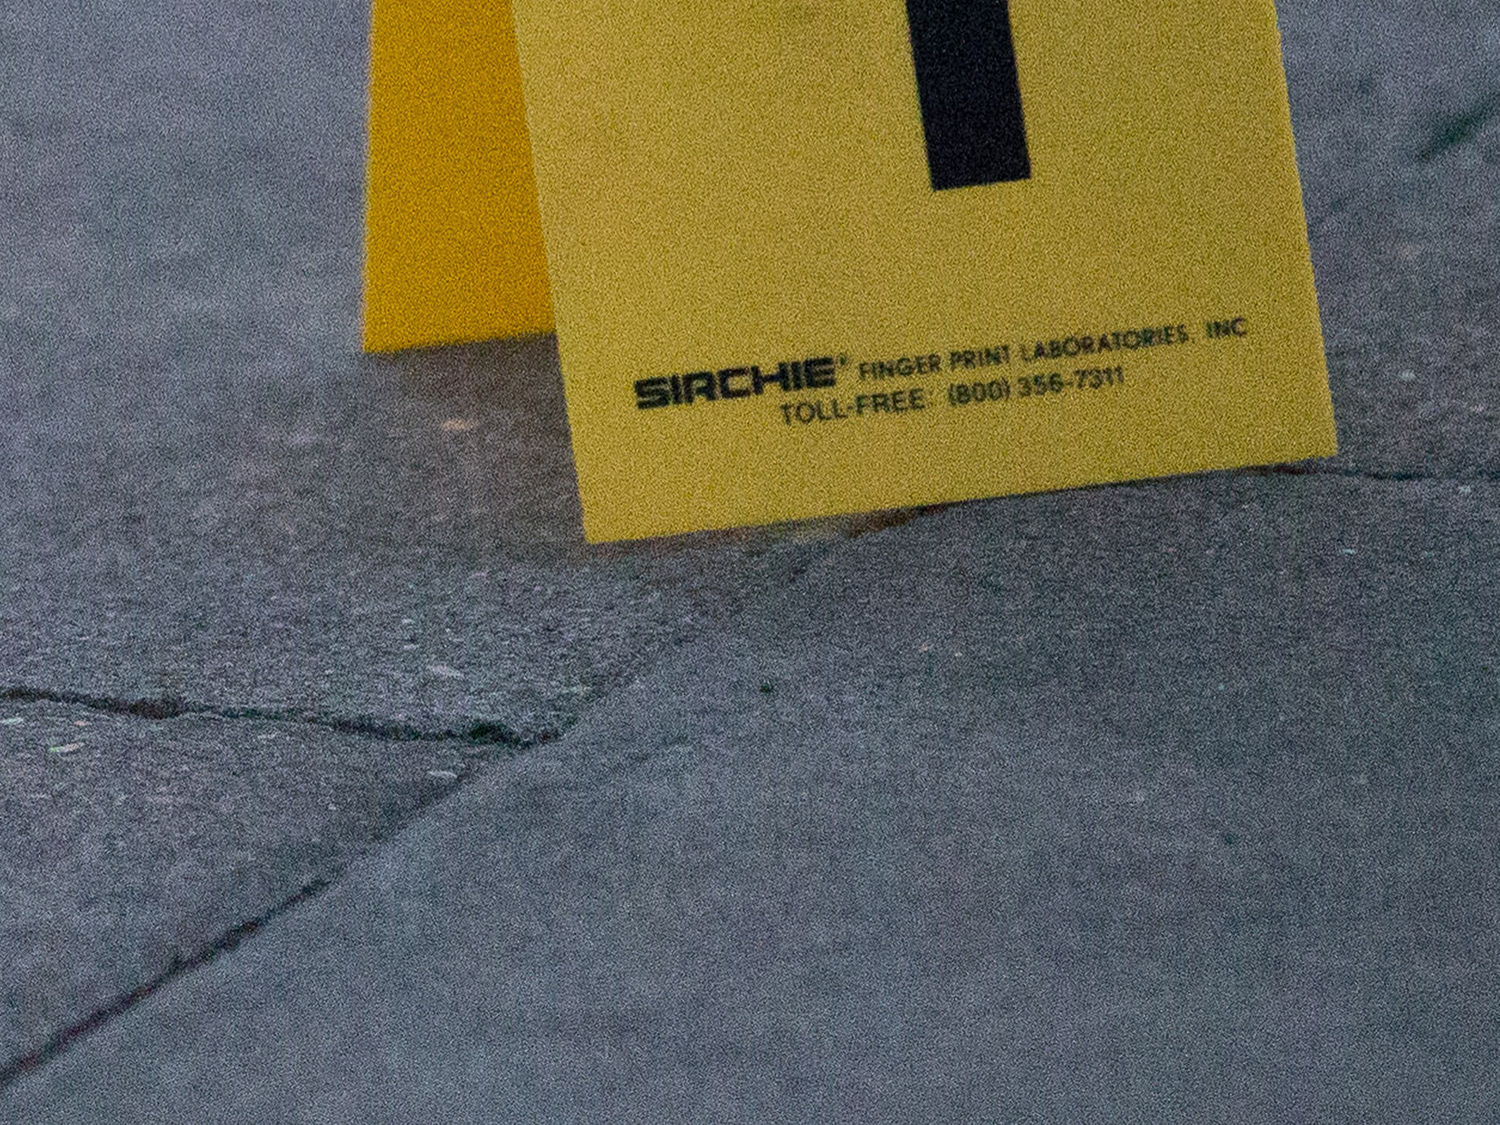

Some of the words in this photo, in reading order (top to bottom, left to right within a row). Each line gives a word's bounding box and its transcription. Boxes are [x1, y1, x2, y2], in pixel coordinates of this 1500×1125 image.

[858, 354, 942, 381] FINGER
[949, 345, 1010, 370] PRINT
[947, 376, 1011, 406] (800)
[1017, 365, 1125, 398] 356-7311
